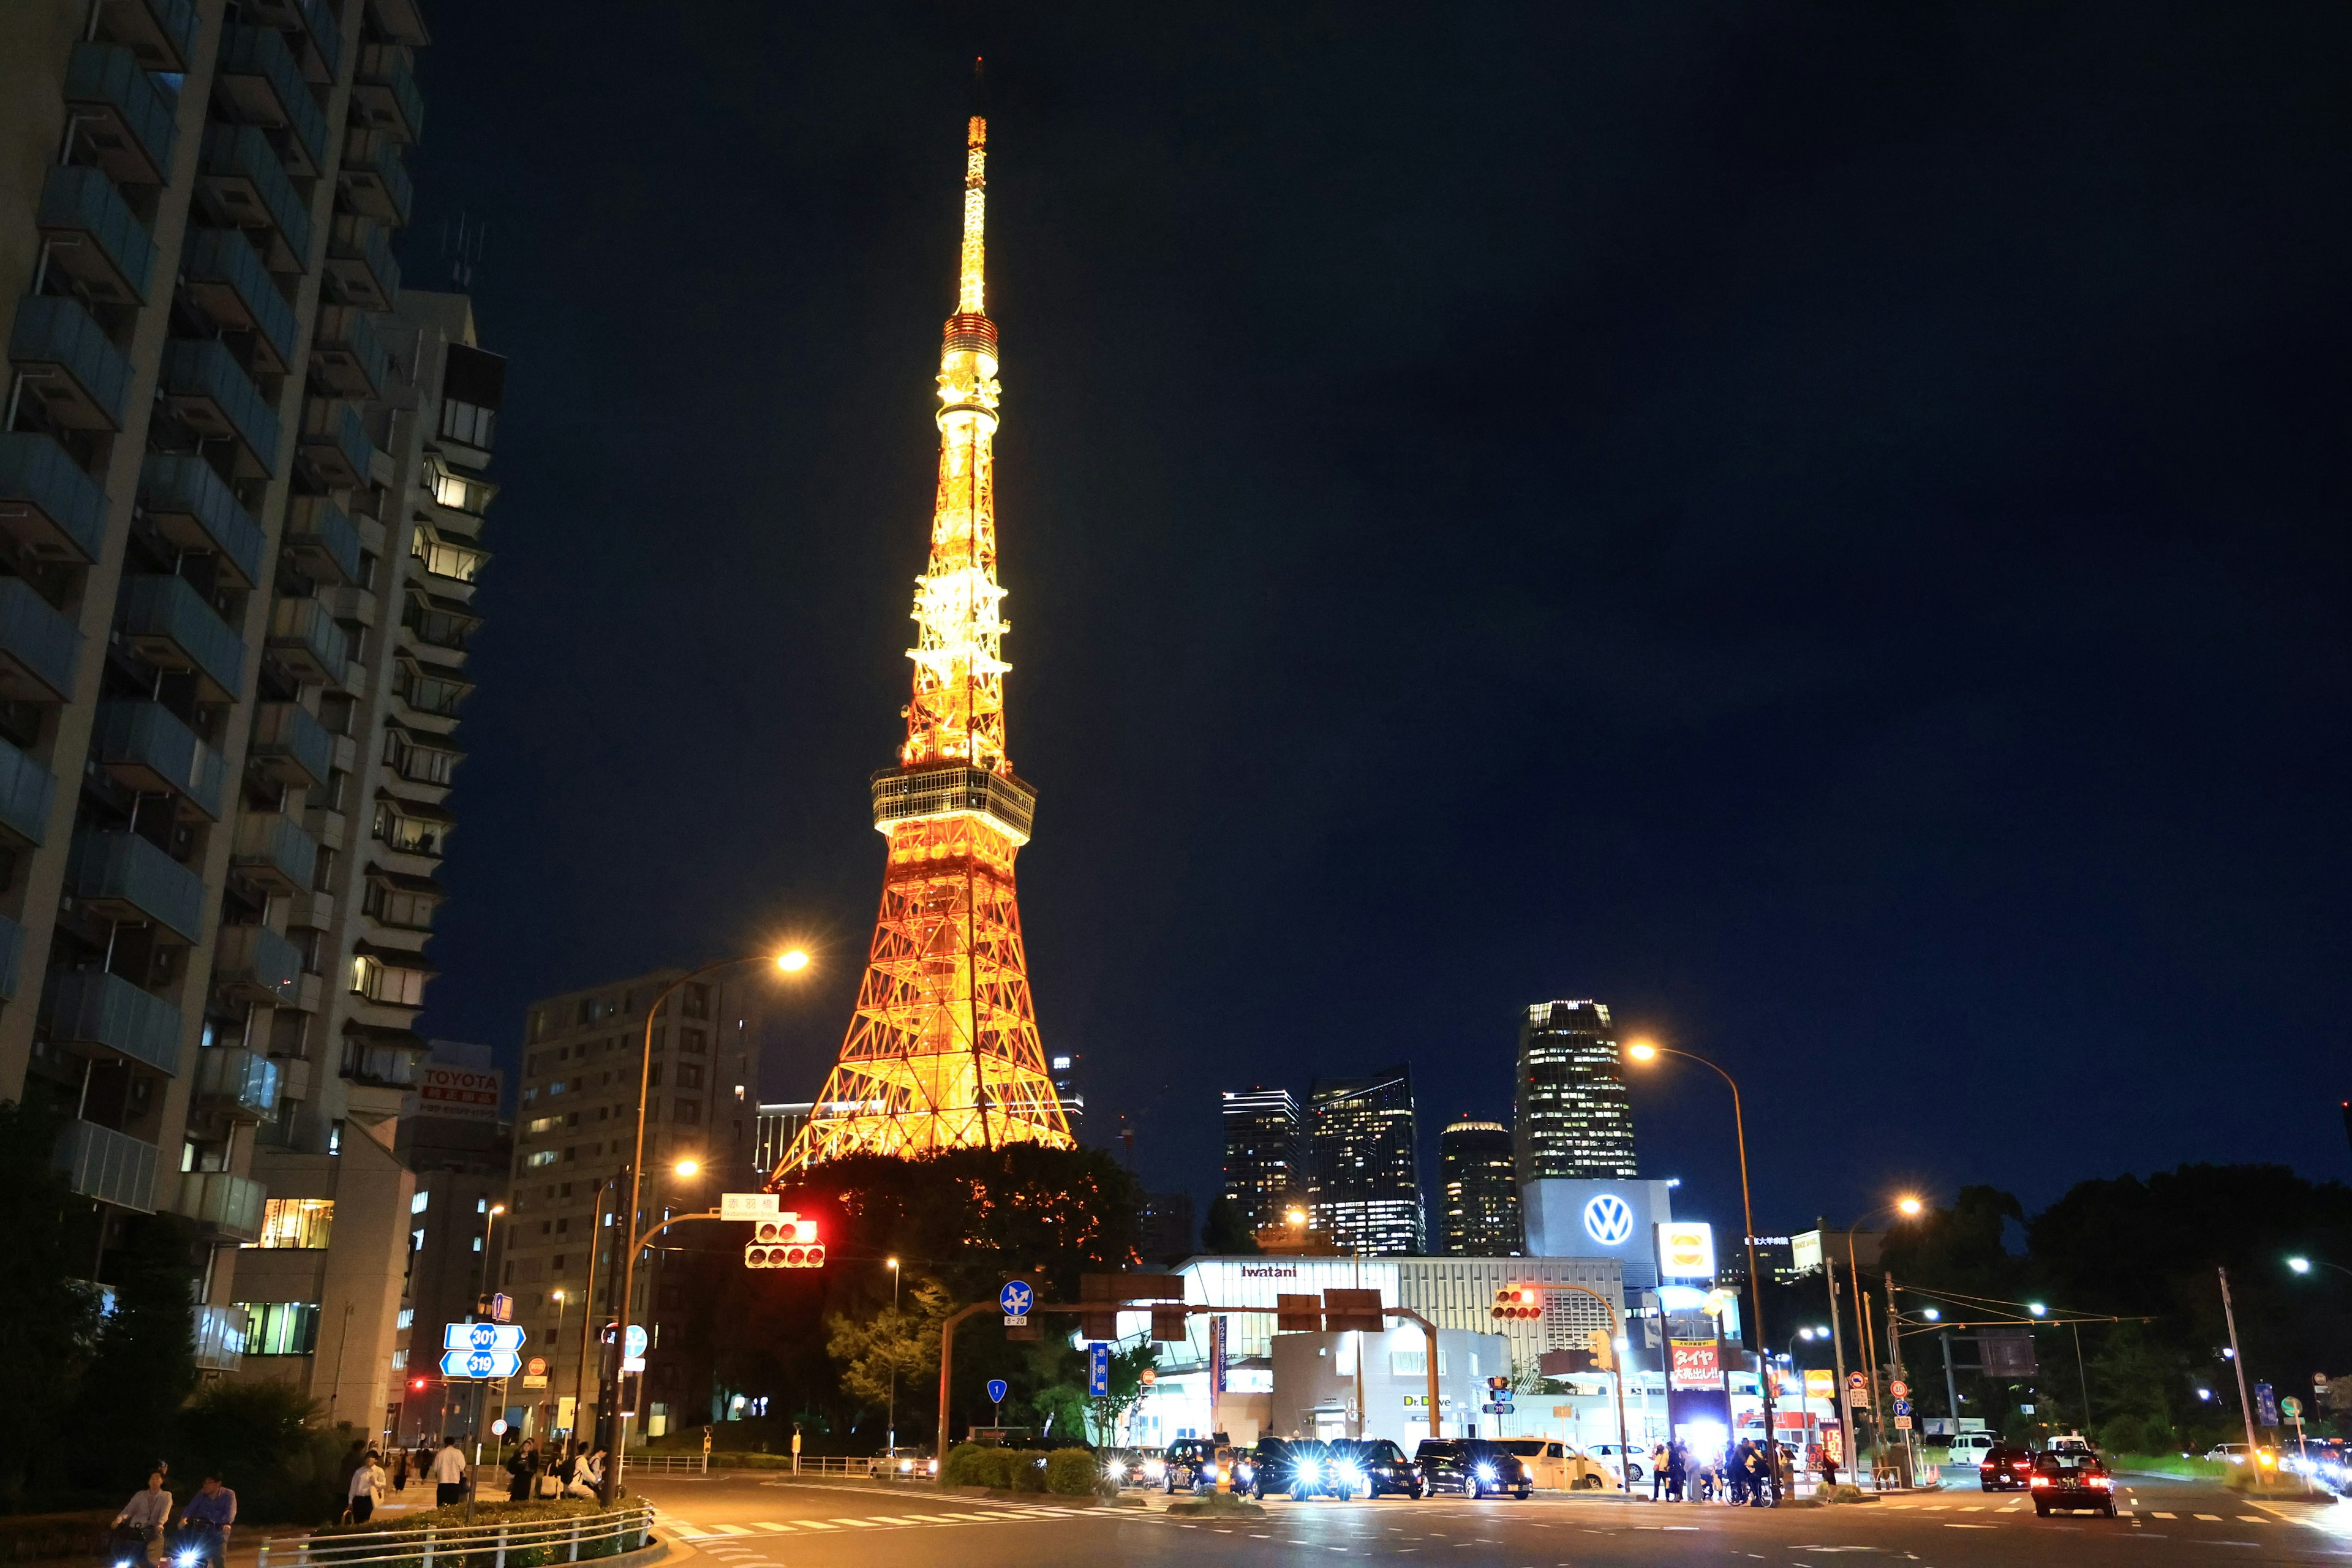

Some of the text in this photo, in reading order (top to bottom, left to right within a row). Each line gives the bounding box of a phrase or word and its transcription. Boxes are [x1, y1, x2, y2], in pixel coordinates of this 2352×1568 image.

[424, 1069, 497, 1090] TOYOTA
[728, 1199, 773, 1209] 赤羽橋
[1242, 1265, 1297, 1277] Iwatani
[472, 1330, 494, 1345] 301
[469, 1356, 492, 1371] 319
[1674, 1349, 1714, 1366] タイヤ
[995, 1385, 999, 1394] 1
[1404, 1396, 1451, 1406] Dr. Dve
[1171, 1472, 1190, 1487] S.RIDE
